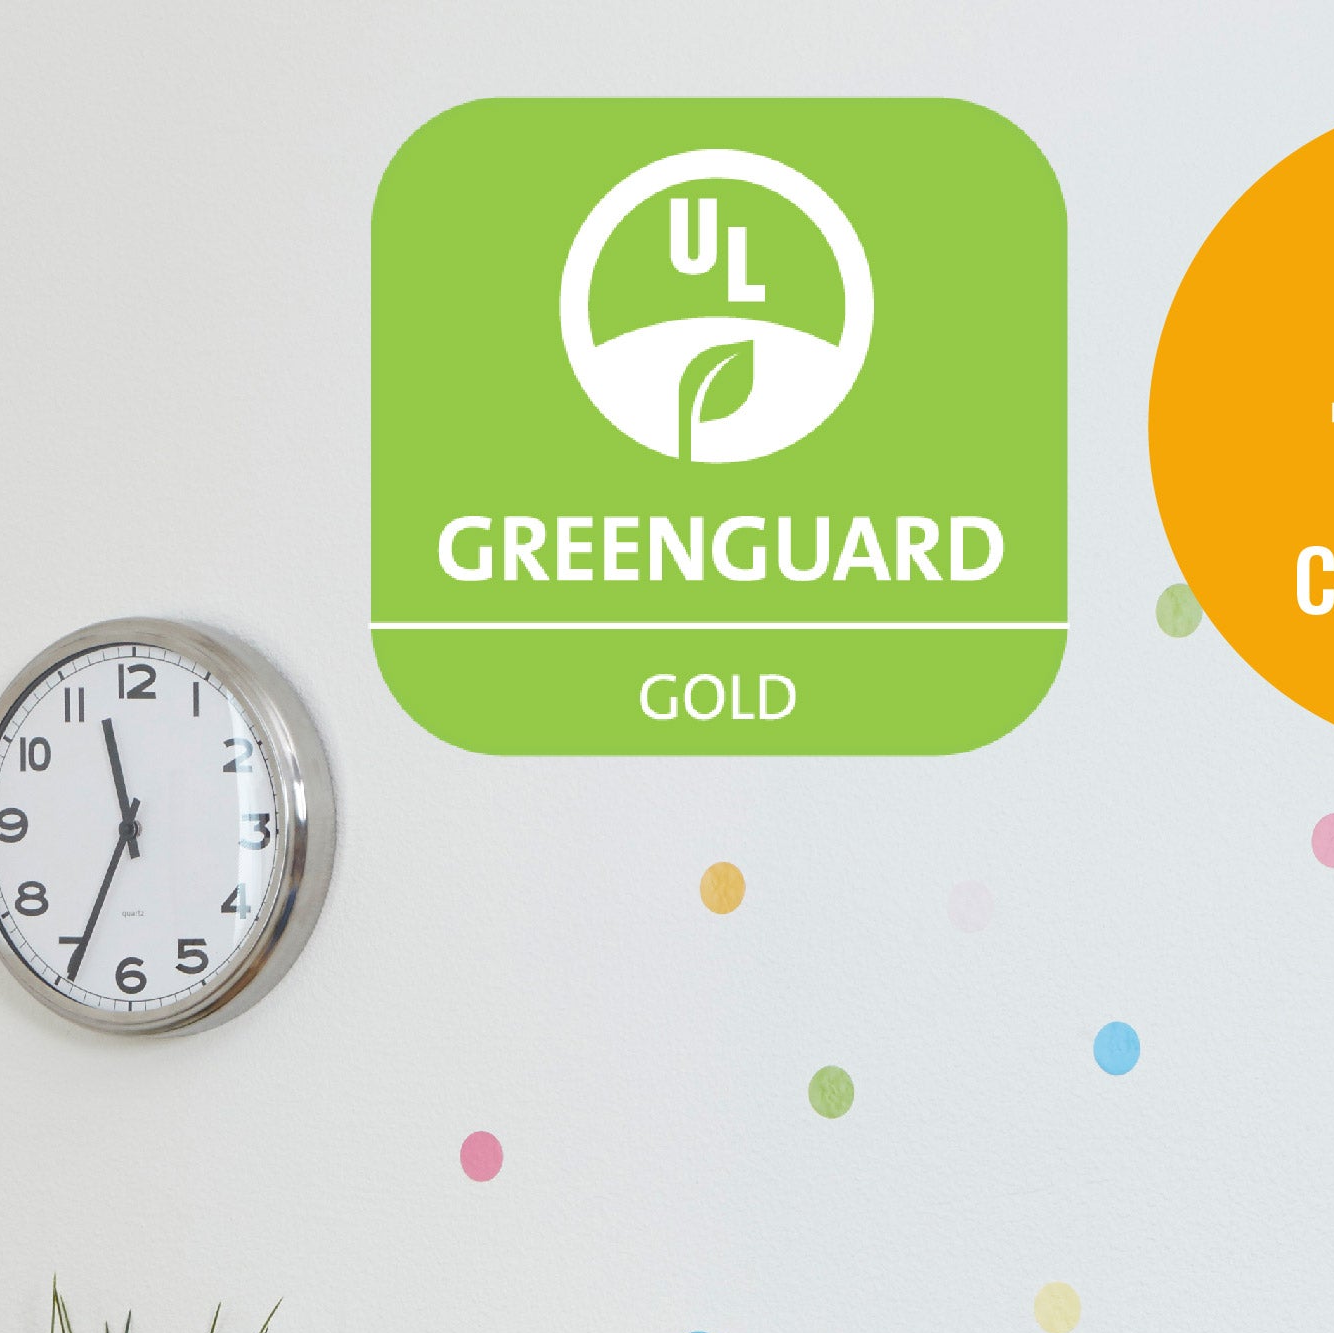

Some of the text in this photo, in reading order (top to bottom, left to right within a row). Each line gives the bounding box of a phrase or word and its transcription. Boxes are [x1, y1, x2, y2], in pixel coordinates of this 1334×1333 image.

[118, 663, 156, 700] 12
[192, 681, 200, 717] 1
[64, 687, 85, 723] 11
[19, 737, 52, 772] 10
[222, 738, 253, 773] 2
[238, 812, 271, 851] 3
[14, 881, 49, 916] 8
[220, 883, 251, 920] 4
[58, 936, 84, 979] 7
[115, 956, 147, 994] 6
[175, 938, 209, 975] 5
